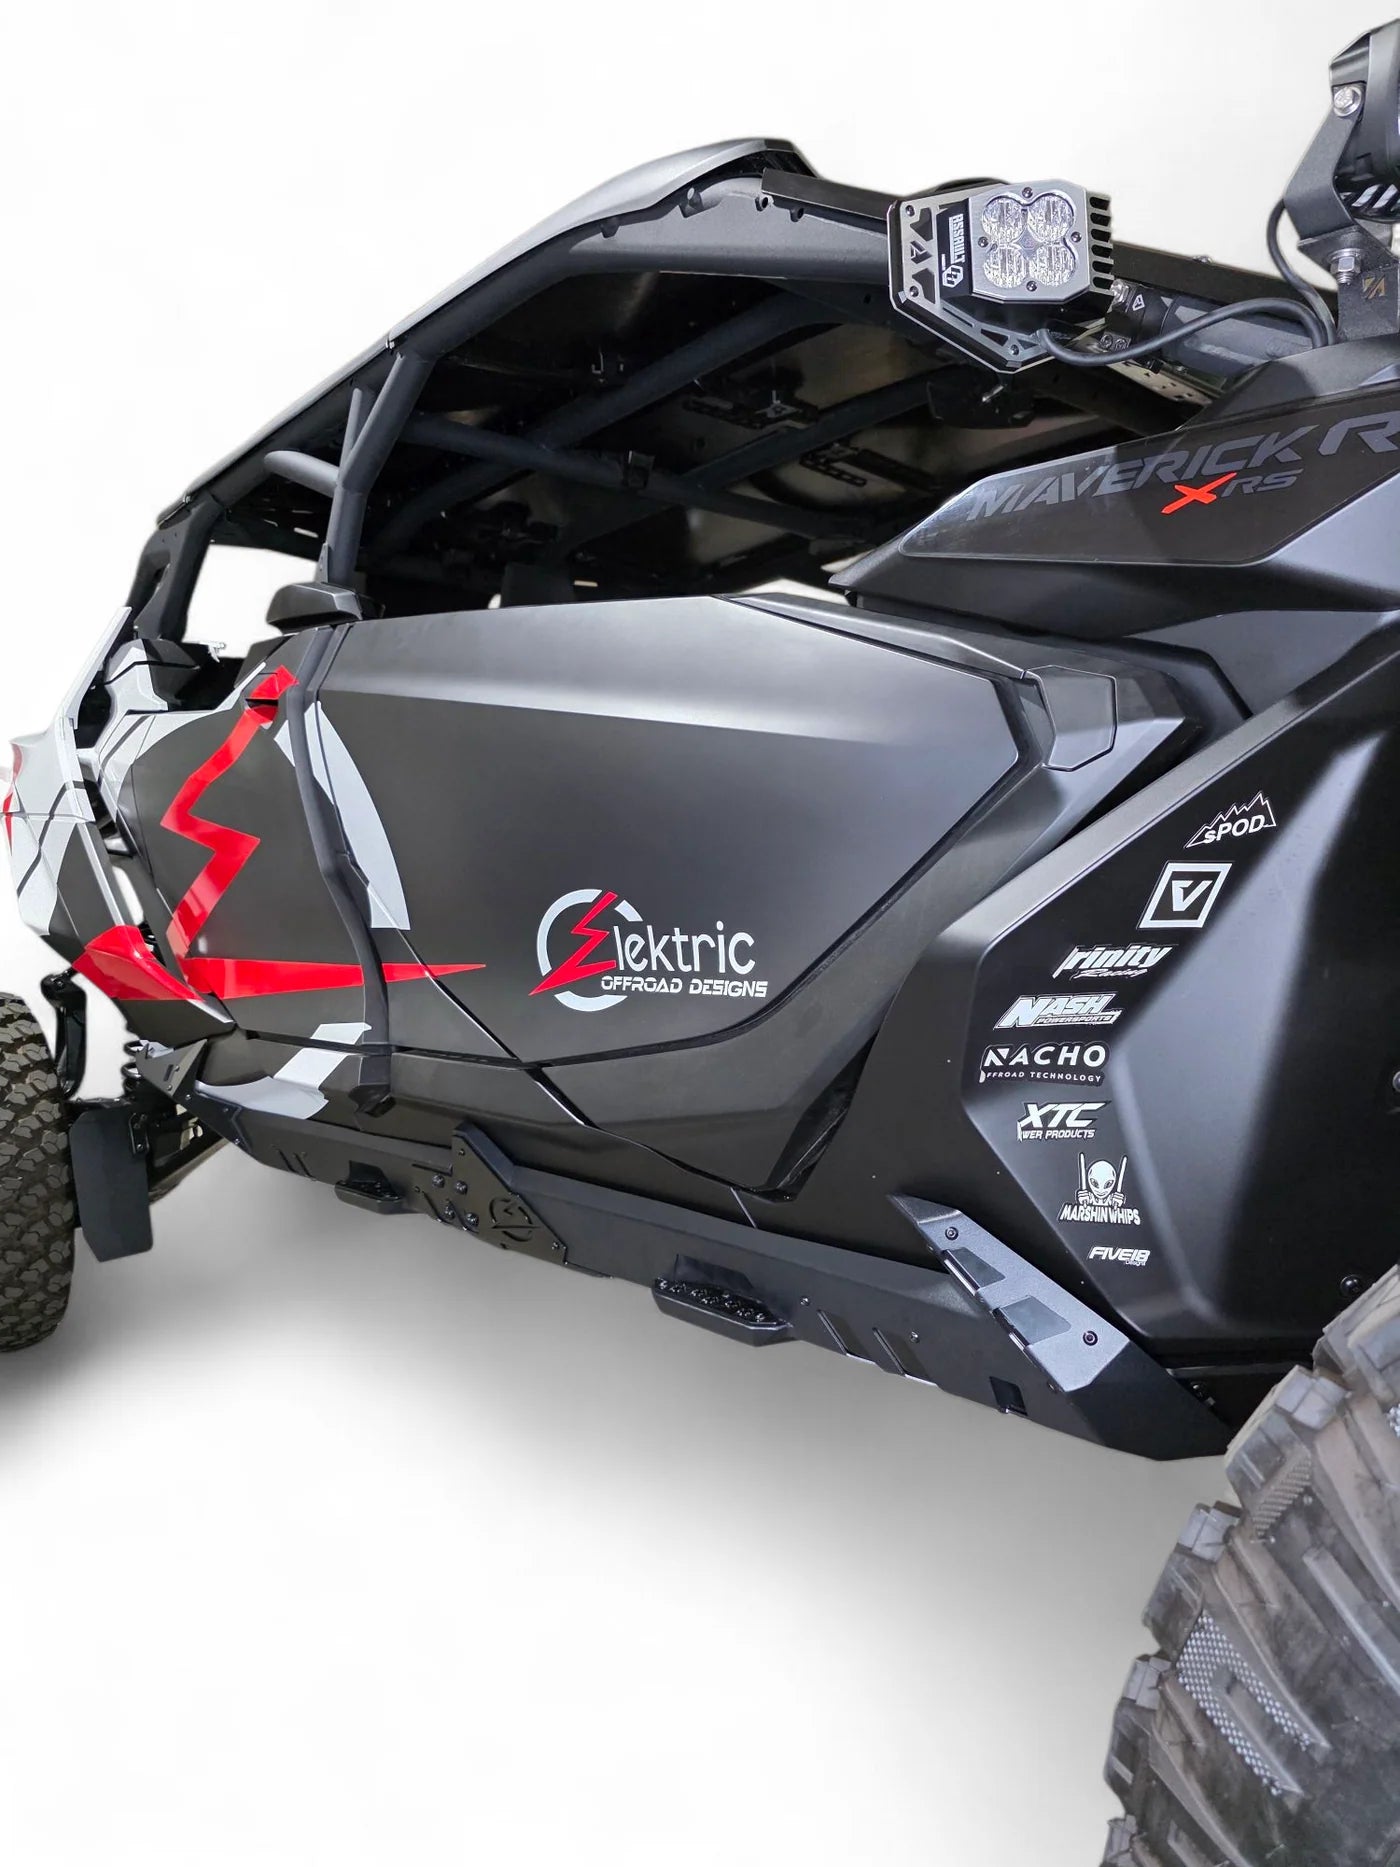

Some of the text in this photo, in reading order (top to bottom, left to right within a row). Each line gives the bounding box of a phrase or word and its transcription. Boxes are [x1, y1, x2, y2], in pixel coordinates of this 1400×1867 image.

[951, 214, 965, 263] ASSAULT
[966, 425, 1318, 521] MAVERICK
[601, 975, 769, 998] OFFROAD DESIGNS
[998, 994, 1116, 1027] NASH
[983, 1045, 1106, 1067] NACHO
[1030, 1071, 1101, 1083] TECHNOLOGY
[1019, 1102, 1106, 1128] XTC
[1045, 1128, 1095, 1140] PRODUCTS
[1060, 1204, 1141, 1225] MARSHIN WHIPS
